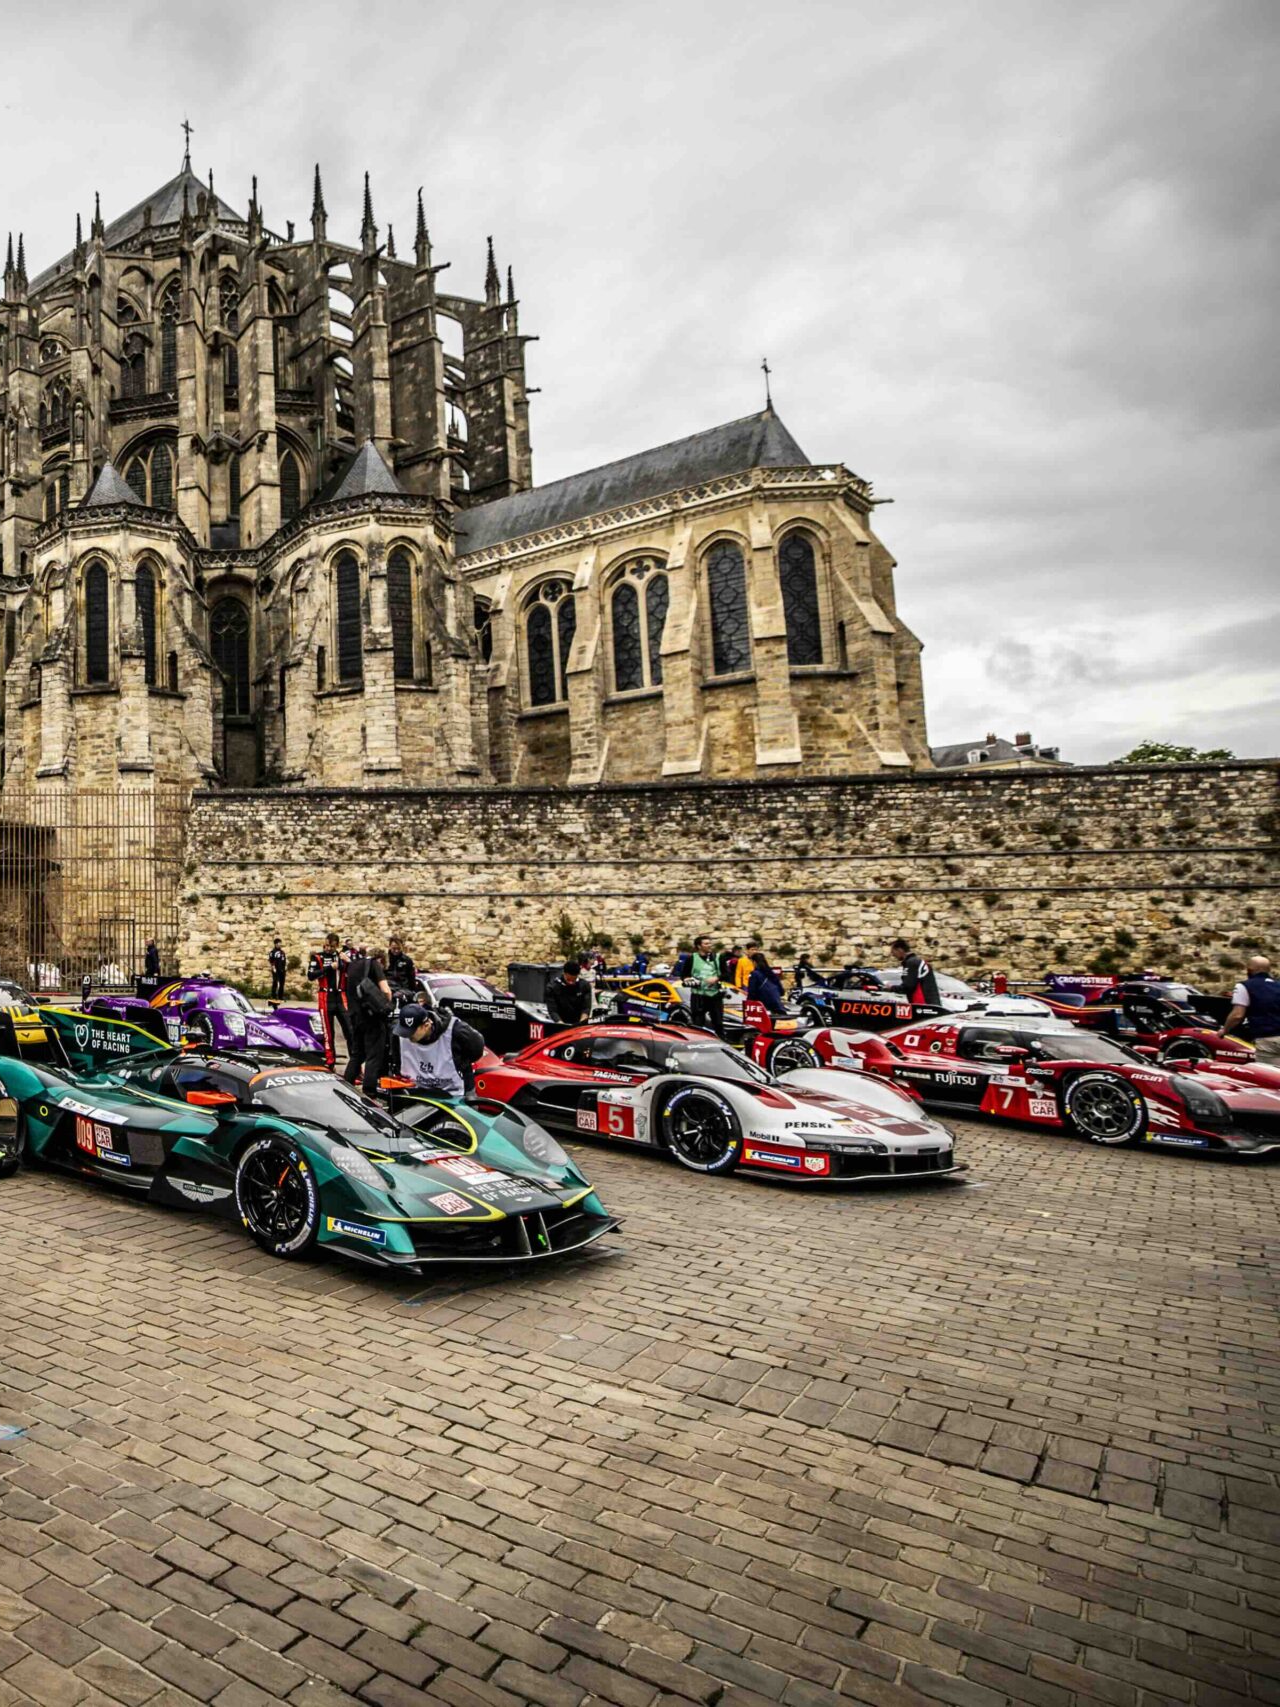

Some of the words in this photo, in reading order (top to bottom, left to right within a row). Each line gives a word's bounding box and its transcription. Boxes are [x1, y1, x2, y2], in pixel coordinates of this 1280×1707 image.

[1058, 976, 1114, 985] CROWDSTRIKE
[453, 1001, 517, 1014] PORSCHE
[745, 1005, 762, 1013] JFE
[841, 1002, 892, 1017] DENSO
[896, 1005, 911, 1017] HY
[91, 1028, 105, 1039] THE
[106, 1030, 131, 1043] HEART
[529, 1023, 543, 1039] HY
[91, 1039, 101, 1049] OF
[102, 1041, 130, 1054] RACING
[265, 1073, 313, 1089] ASTON
[935, 1071, 977, 1086] FUJITSU
[999, 1088, 1014, 1110] 7
[1032, 1106, 1055, 1116] CAR
[579, 1117, 596, 1129] CAR
[608, 1105, 625, 1133] 5
[76, 1116, 93, 1151] 009
[96, 1132, 111, 1148] CAR
[749, 1130, 771, 1140] Mobil
[467, 1183, 495, 1194] THE
[492, 1178, 531, 1190] HEART
[305, 1178, 315, 1226] MICHELIN
[482, 1192, 500, 1201] OF
[440, 1198, 471, 1214] CAR
[343, 1225, 381, 1240] MICHELIN
